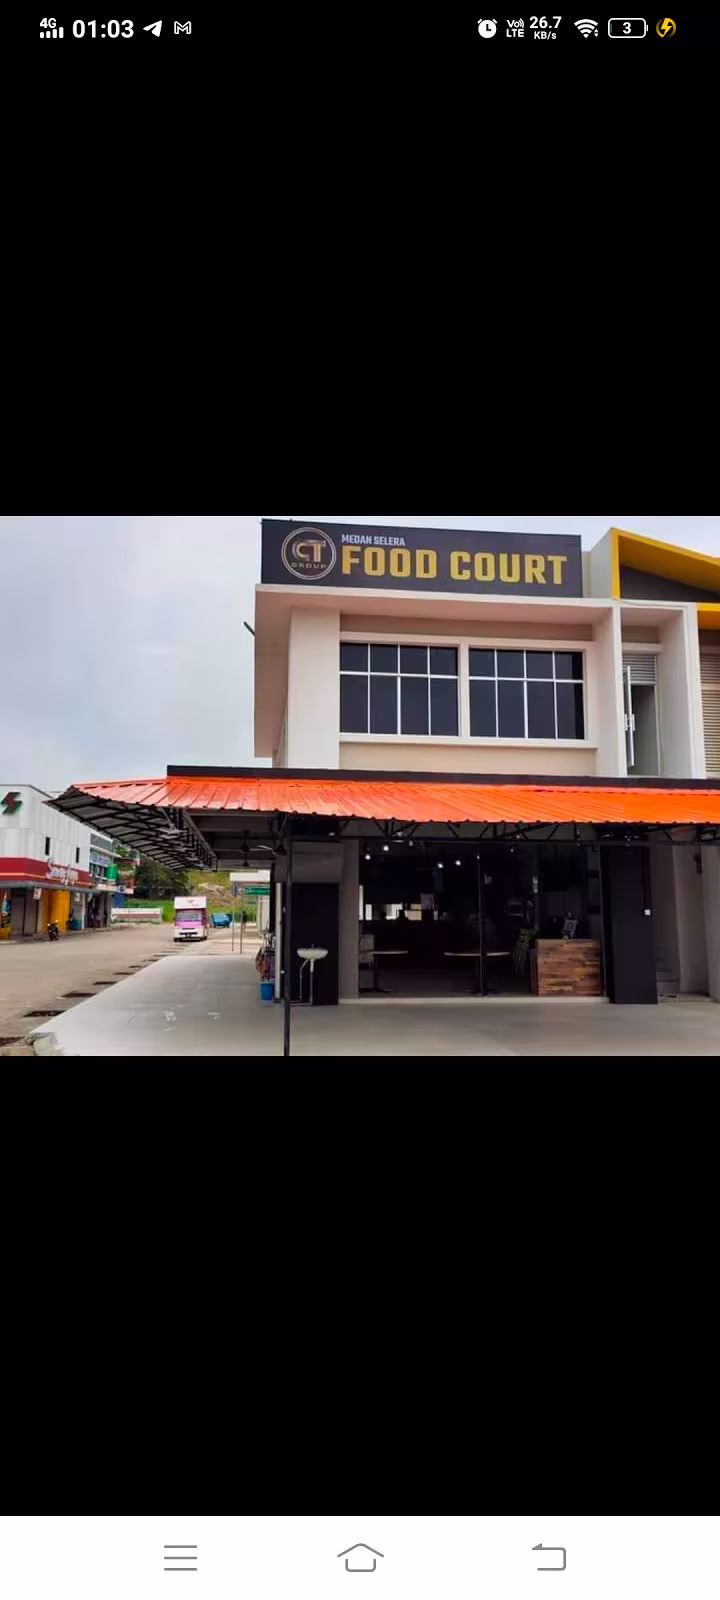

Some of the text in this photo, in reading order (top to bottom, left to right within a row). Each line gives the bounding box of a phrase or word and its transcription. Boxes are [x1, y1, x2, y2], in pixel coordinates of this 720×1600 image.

[341, 534, 405, 547] MEDAN SELERA
[290, 561, 327, 570] GROUP
[341, 546, 567, 585] FOOD COURT
